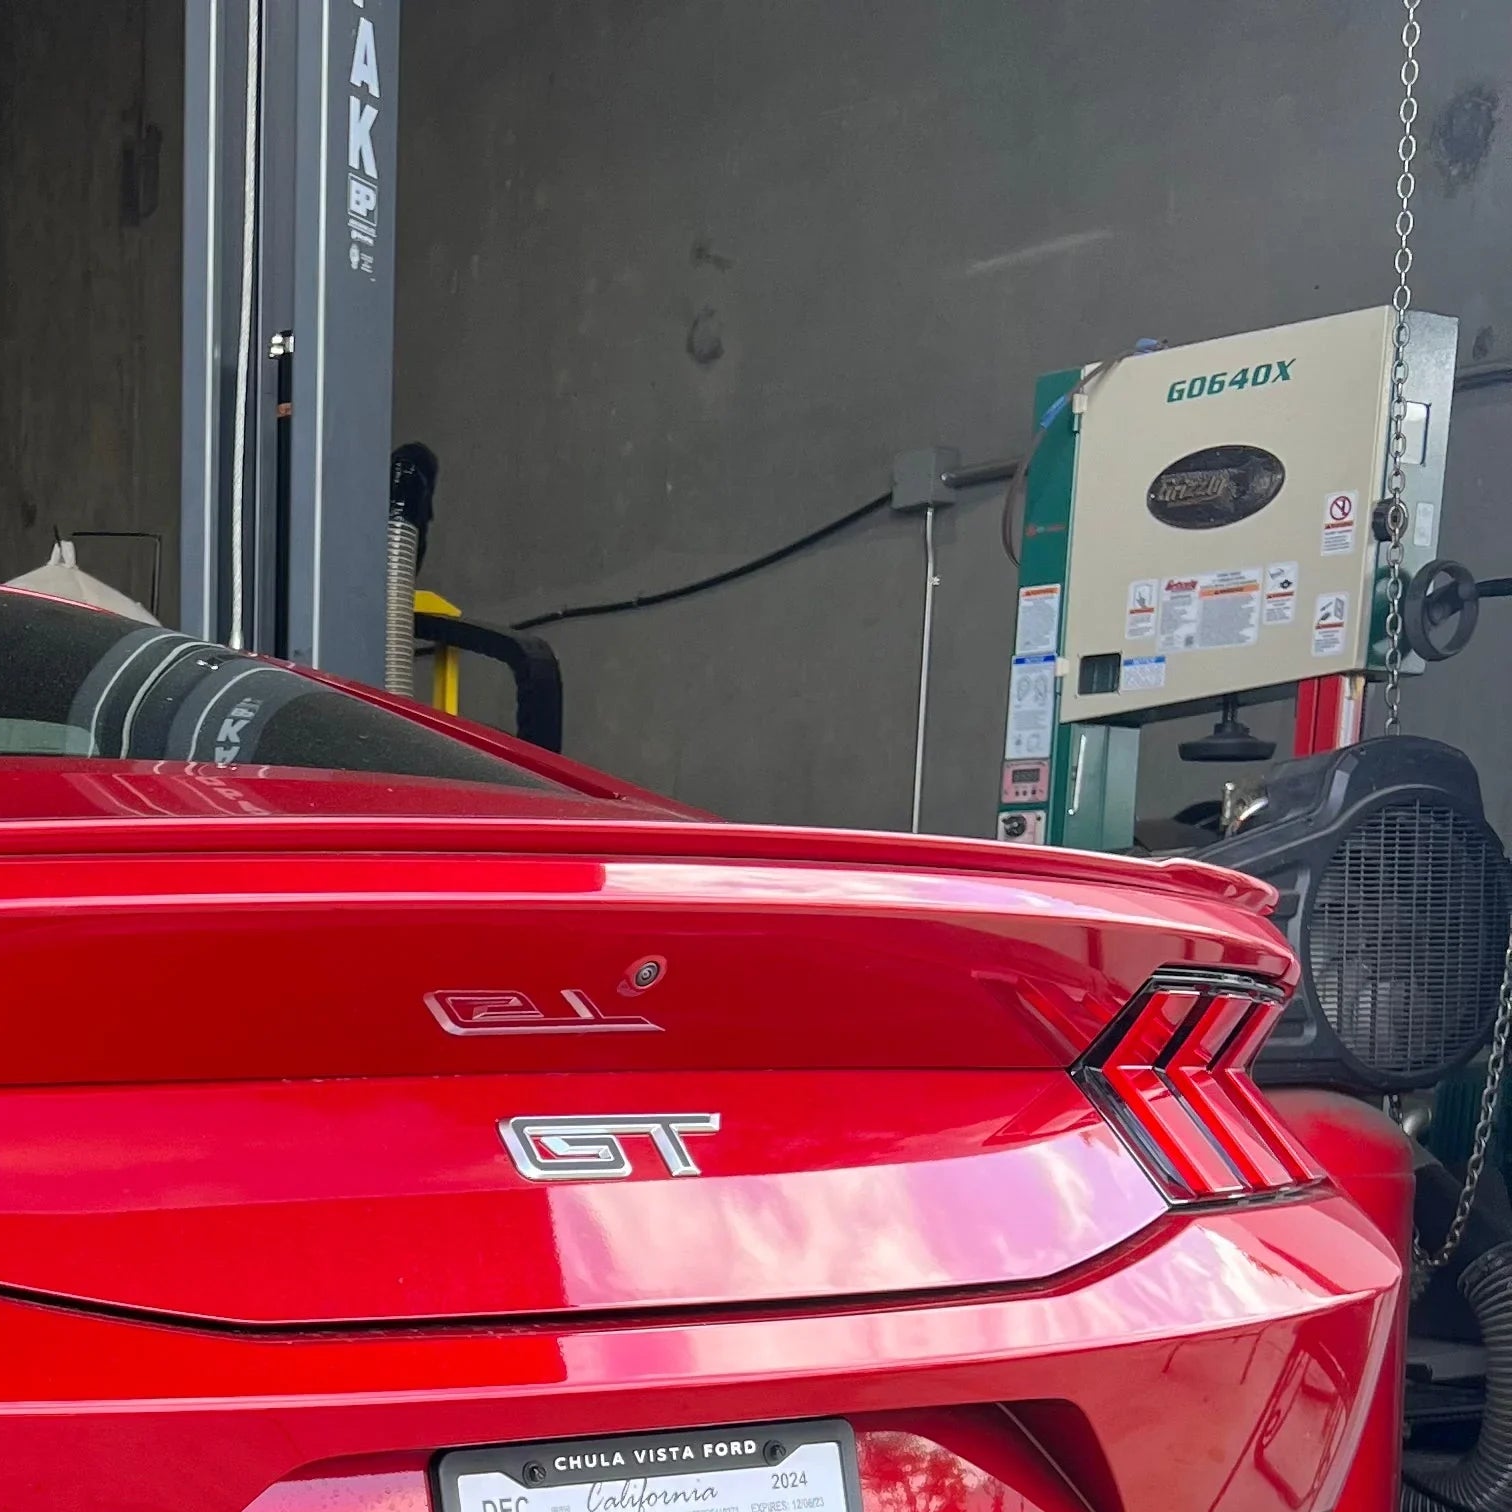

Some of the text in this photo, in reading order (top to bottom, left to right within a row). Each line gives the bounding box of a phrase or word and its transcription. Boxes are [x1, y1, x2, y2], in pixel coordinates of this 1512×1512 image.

[498, 1112, 721, 1182] GT
[554, 1440, 756, 1471] CHULA VISTA FORD
[771, 1472, 808, 1489] 2024
